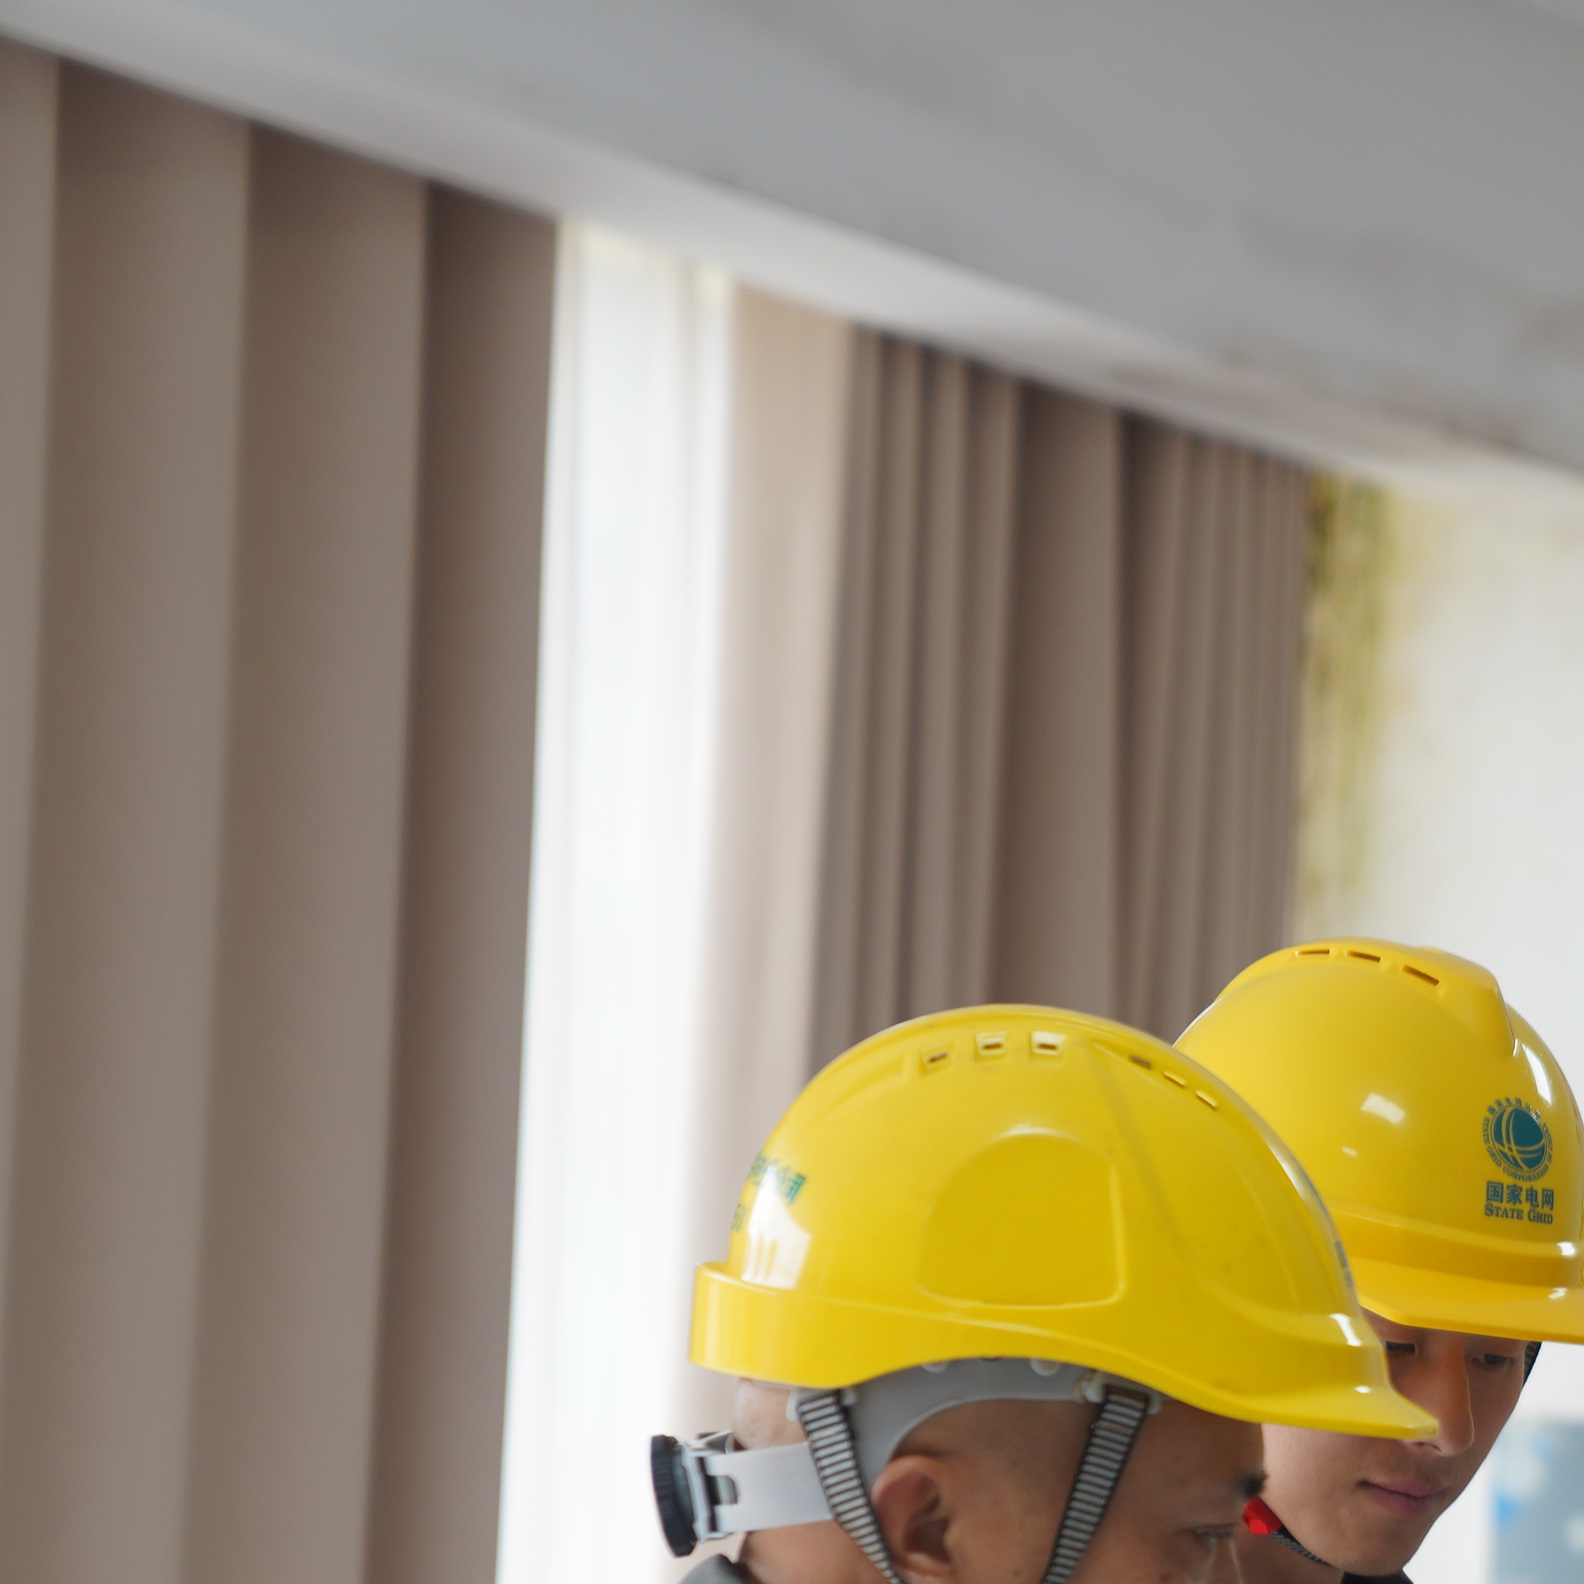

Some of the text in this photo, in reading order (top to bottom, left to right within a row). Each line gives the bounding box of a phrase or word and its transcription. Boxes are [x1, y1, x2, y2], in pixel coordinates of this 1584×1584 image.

[1486, 1180, 1554, 1211] 国家电网
[1484, 1202, 1554, 1225] STATE GRID
